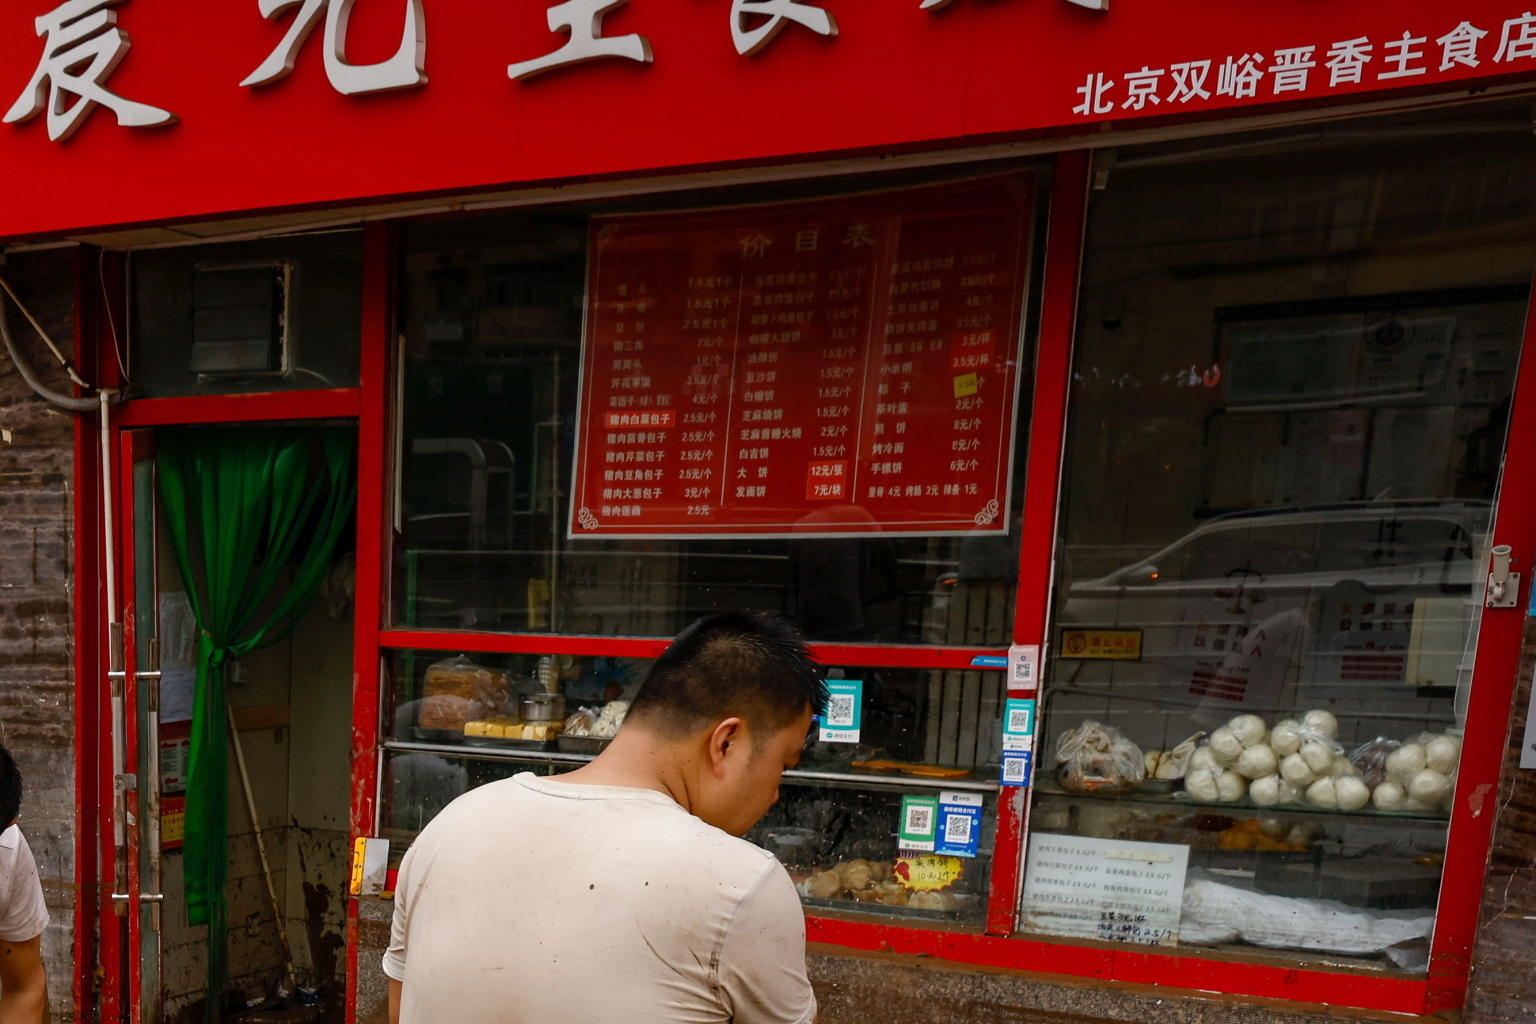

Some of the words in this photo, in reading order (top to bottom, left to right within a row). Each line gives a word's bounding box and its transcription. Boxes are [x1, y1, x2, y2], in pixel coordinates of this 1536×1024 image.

[1072, 11, 1536, 117] 北京双峪晋香主食店
[739, 222, 879, 259] 价目表
[691, 391, 719, 405] 4元/个
[818, 384, 852, 398] 1.5元/个
[954, 396, 985, 411] 2元/个
[609, 412, 671, 426] 猪肉白菜包子
[683, 410, 717, 424] 2.5元/个
[742, 407, 783, 422] 芝麻烧饼
[816, 404, 850, 418] 1.5元/个
[607, 431, 667, 445] 猪肉茴香包子
[681, 430, 715, 443] 2.5元/个
[820, 424, 849, 438] 2元/个
[605, 449, 666, 464] 猪肉芹菜包子
[680, 448, 714, 462] 2.5元/个
[739, 447, 770, 461] 白吉饼
[812, 444, 846, 458] 1.5元/个
[811, 463, 844, 477] 12元/张
[950, 458, 979, 472] 6元/个
[604, 468, 664, 482] 猪肉豆角包子
[678, 466, 713, 480] 2.5元/个
[602, 486, 663, 500] 猪肉大葱包子
[684, 485, 712, 499] 3元/个
[813, 483, 842, 497] 7元/块
[687, 504, 711, 517] 2.5元
